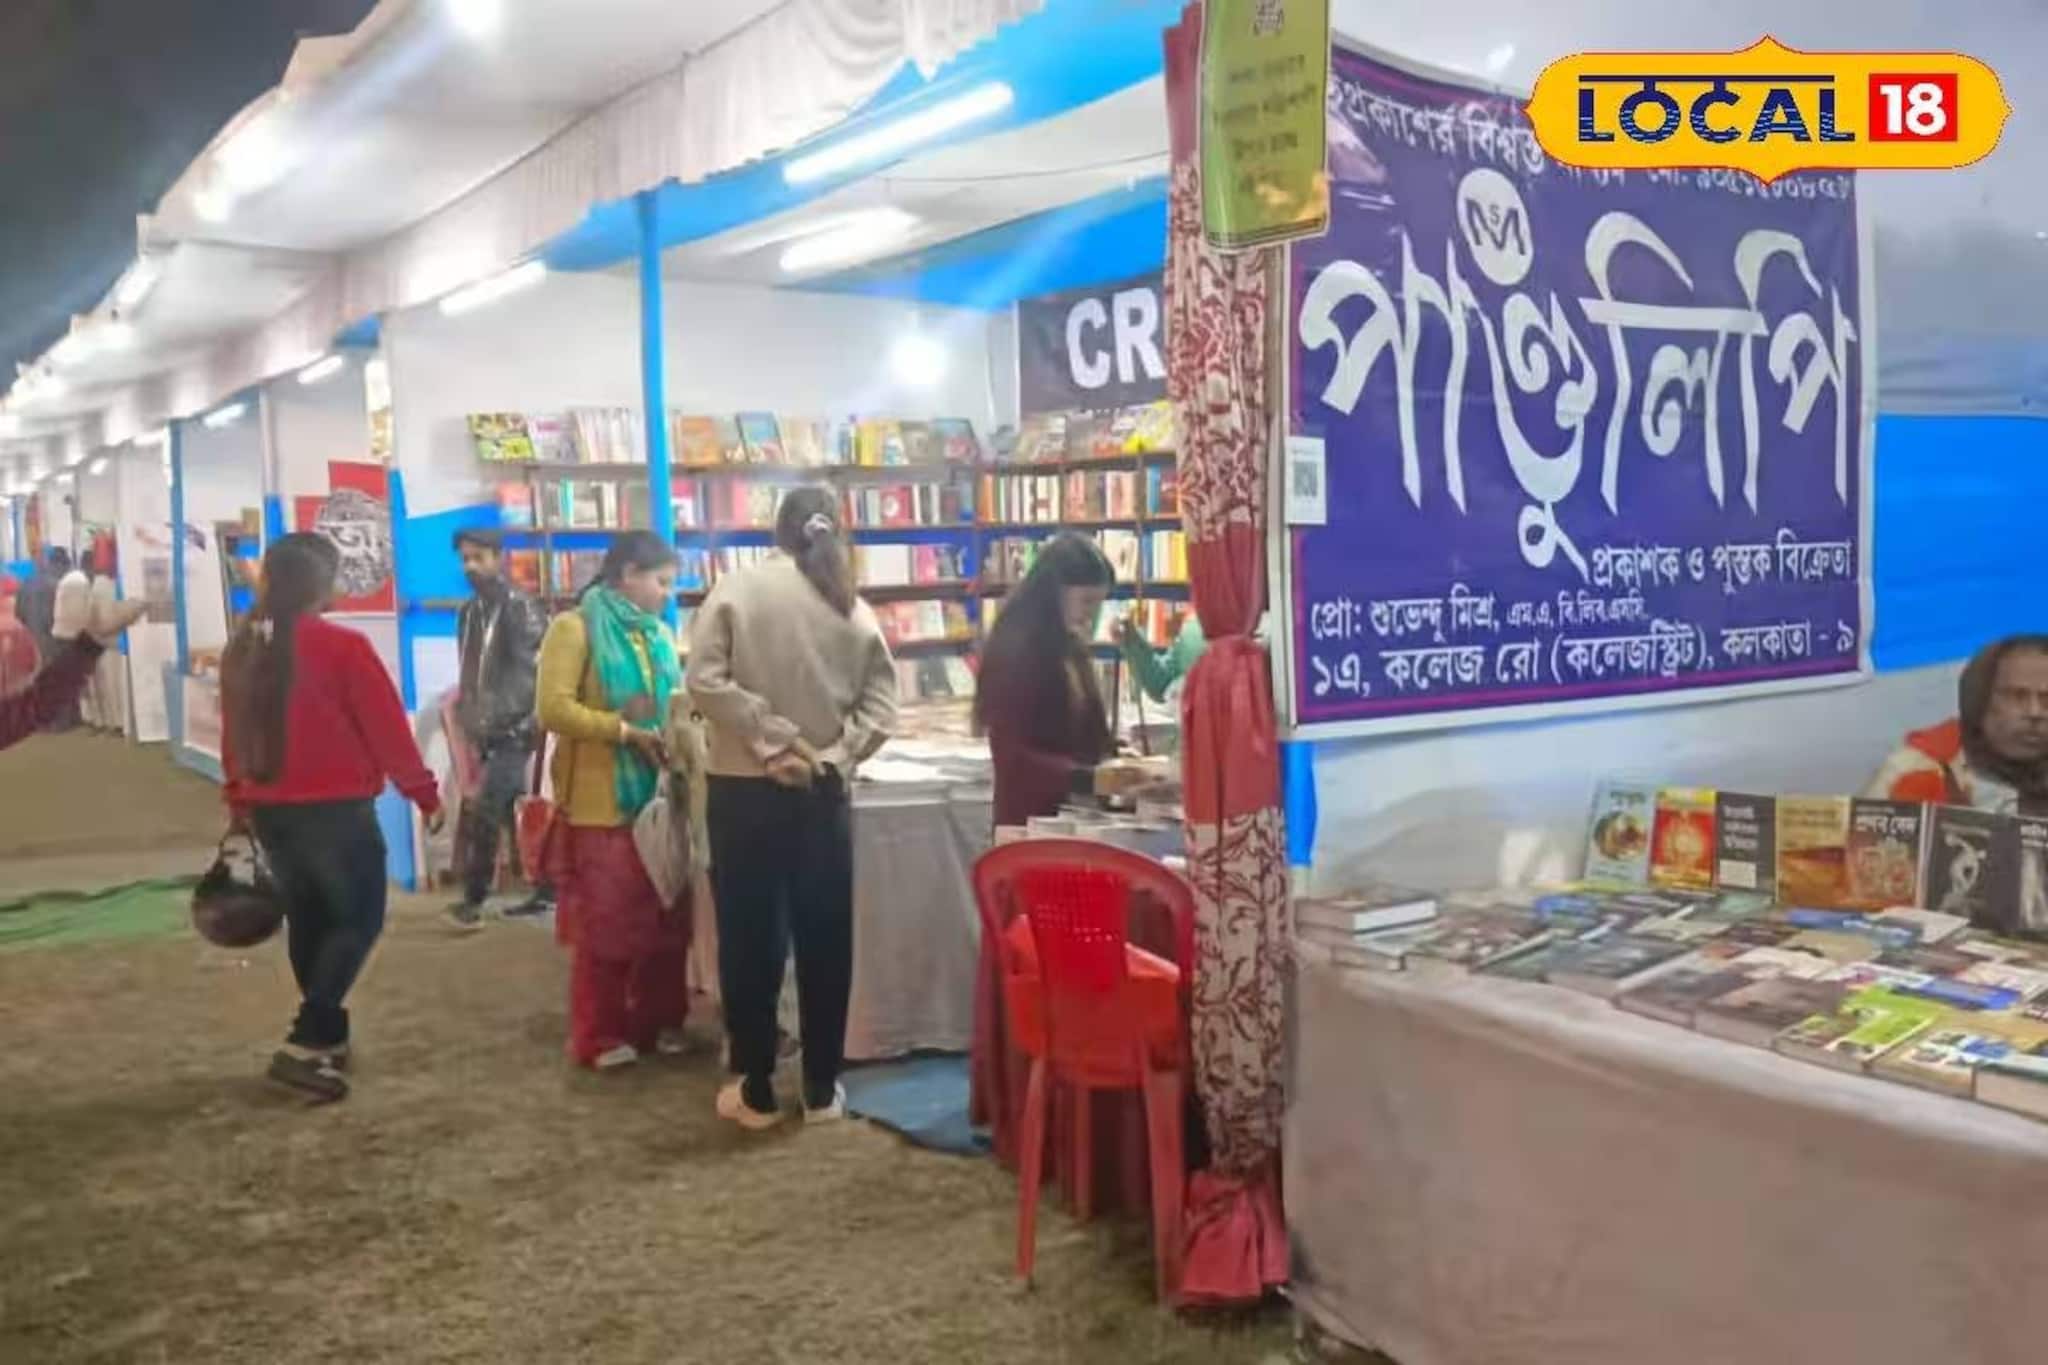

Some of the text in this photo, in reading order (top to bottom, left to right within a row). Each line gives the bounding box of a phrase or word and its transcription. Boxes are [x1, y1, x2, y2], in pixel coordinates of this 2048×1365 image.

[1592, 527, 1853, 595] প্রকাশক ও পুস্তক বিক্রেতা
[1370, 597, 1447, 643] শুভেন্দু
[1448, 583, 1500, 636] মিশ্র,
[1312, 653, 1370, 697] ১এ,
[1378, 645, 1486, 691] কলেজ
[1496, 638, 1541, 684] রো
[1720, 618, 1812, 664] কলকাতা
